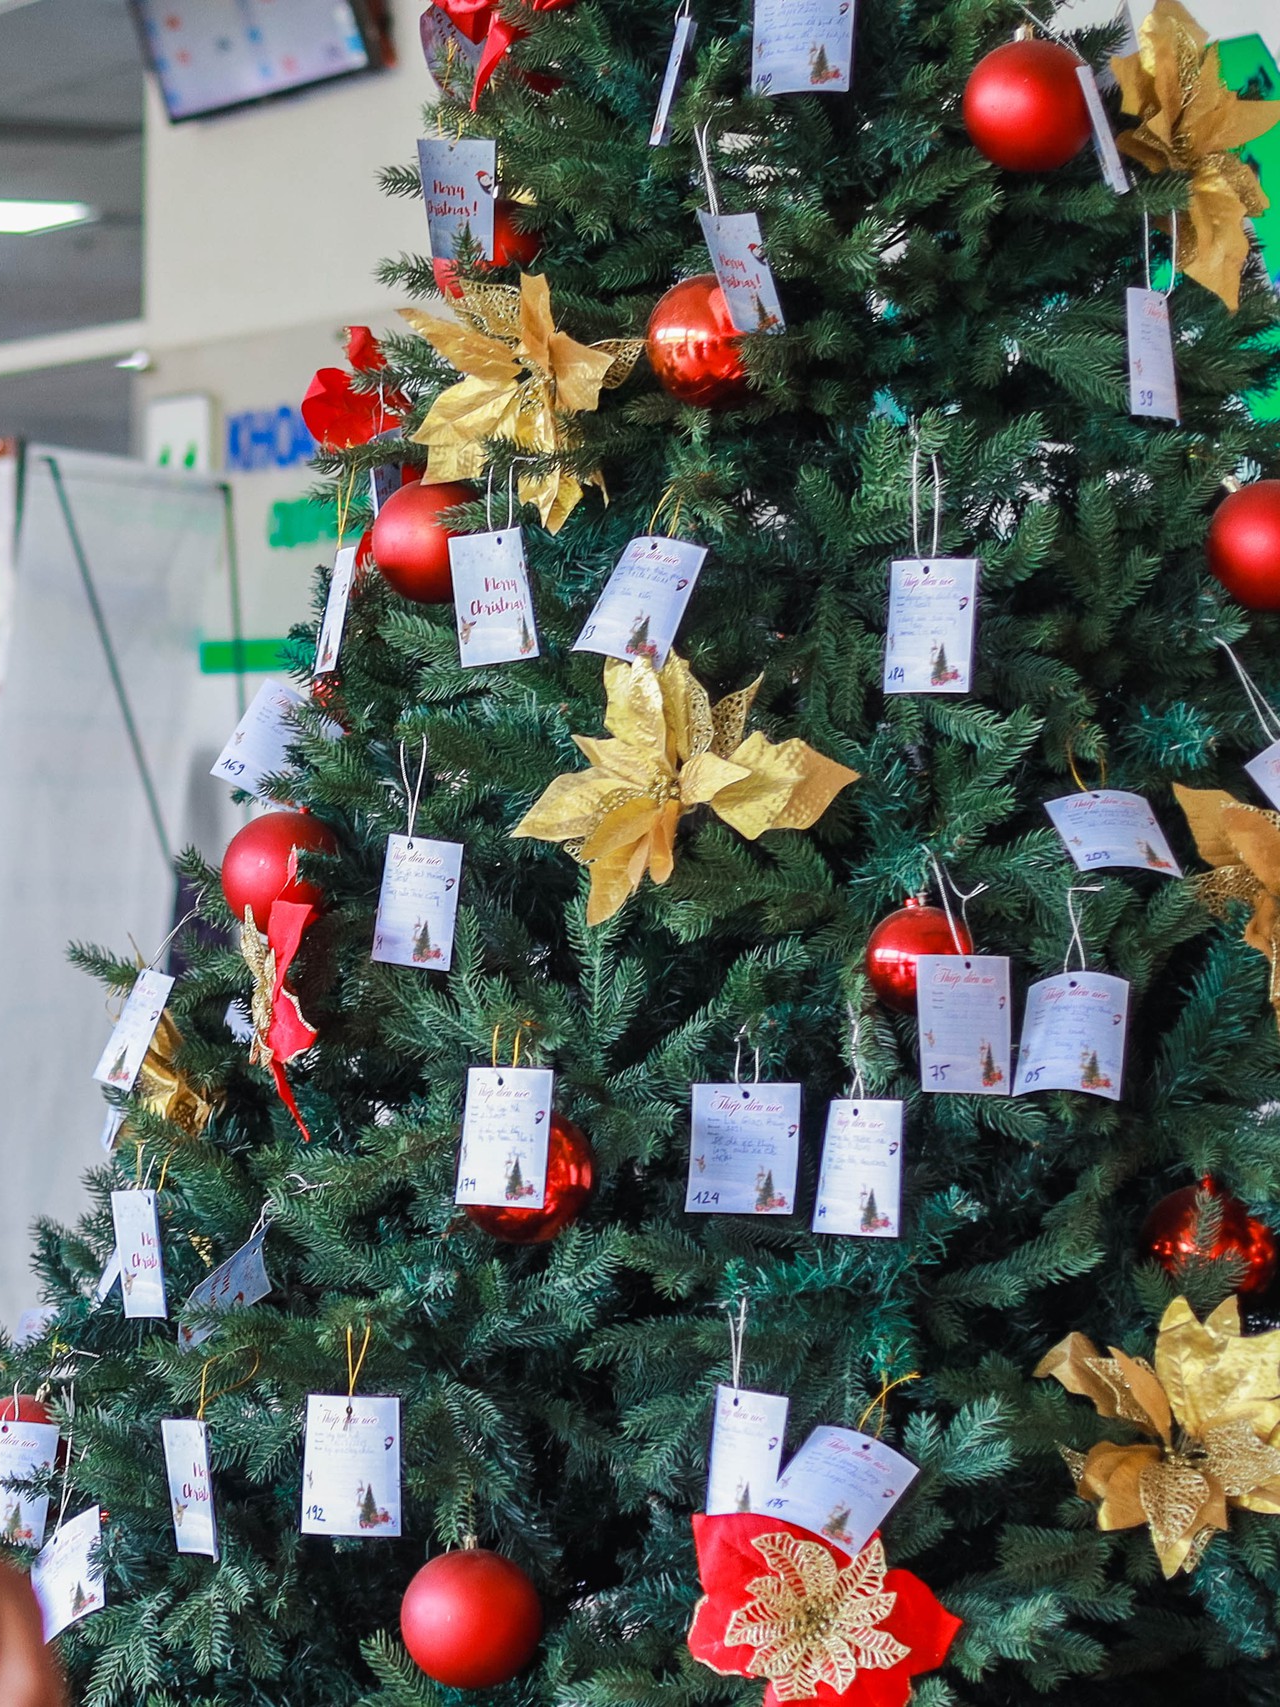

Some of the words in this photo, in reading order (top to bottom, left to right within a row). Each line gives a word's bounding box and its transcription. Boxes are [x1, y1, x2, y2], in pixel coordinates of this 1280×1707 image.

[433, 179, 464, 200] Merry
[1140, 390, 1153, 407] 39
[484, 577, 517, 592] Merry
[470, 594, 528, 616] Christmas!
[221, 759, 246, 776] 169
[1084, 852, 1111, 862] 203
[929, 1064, 951, 1081] 75
[1024, 1066, 1047, 1084] 05
[692, 1191, 721, 1205] 124
[765, 1498, 789, 1509] 175
[305, 1505, 327, 1522] 192
